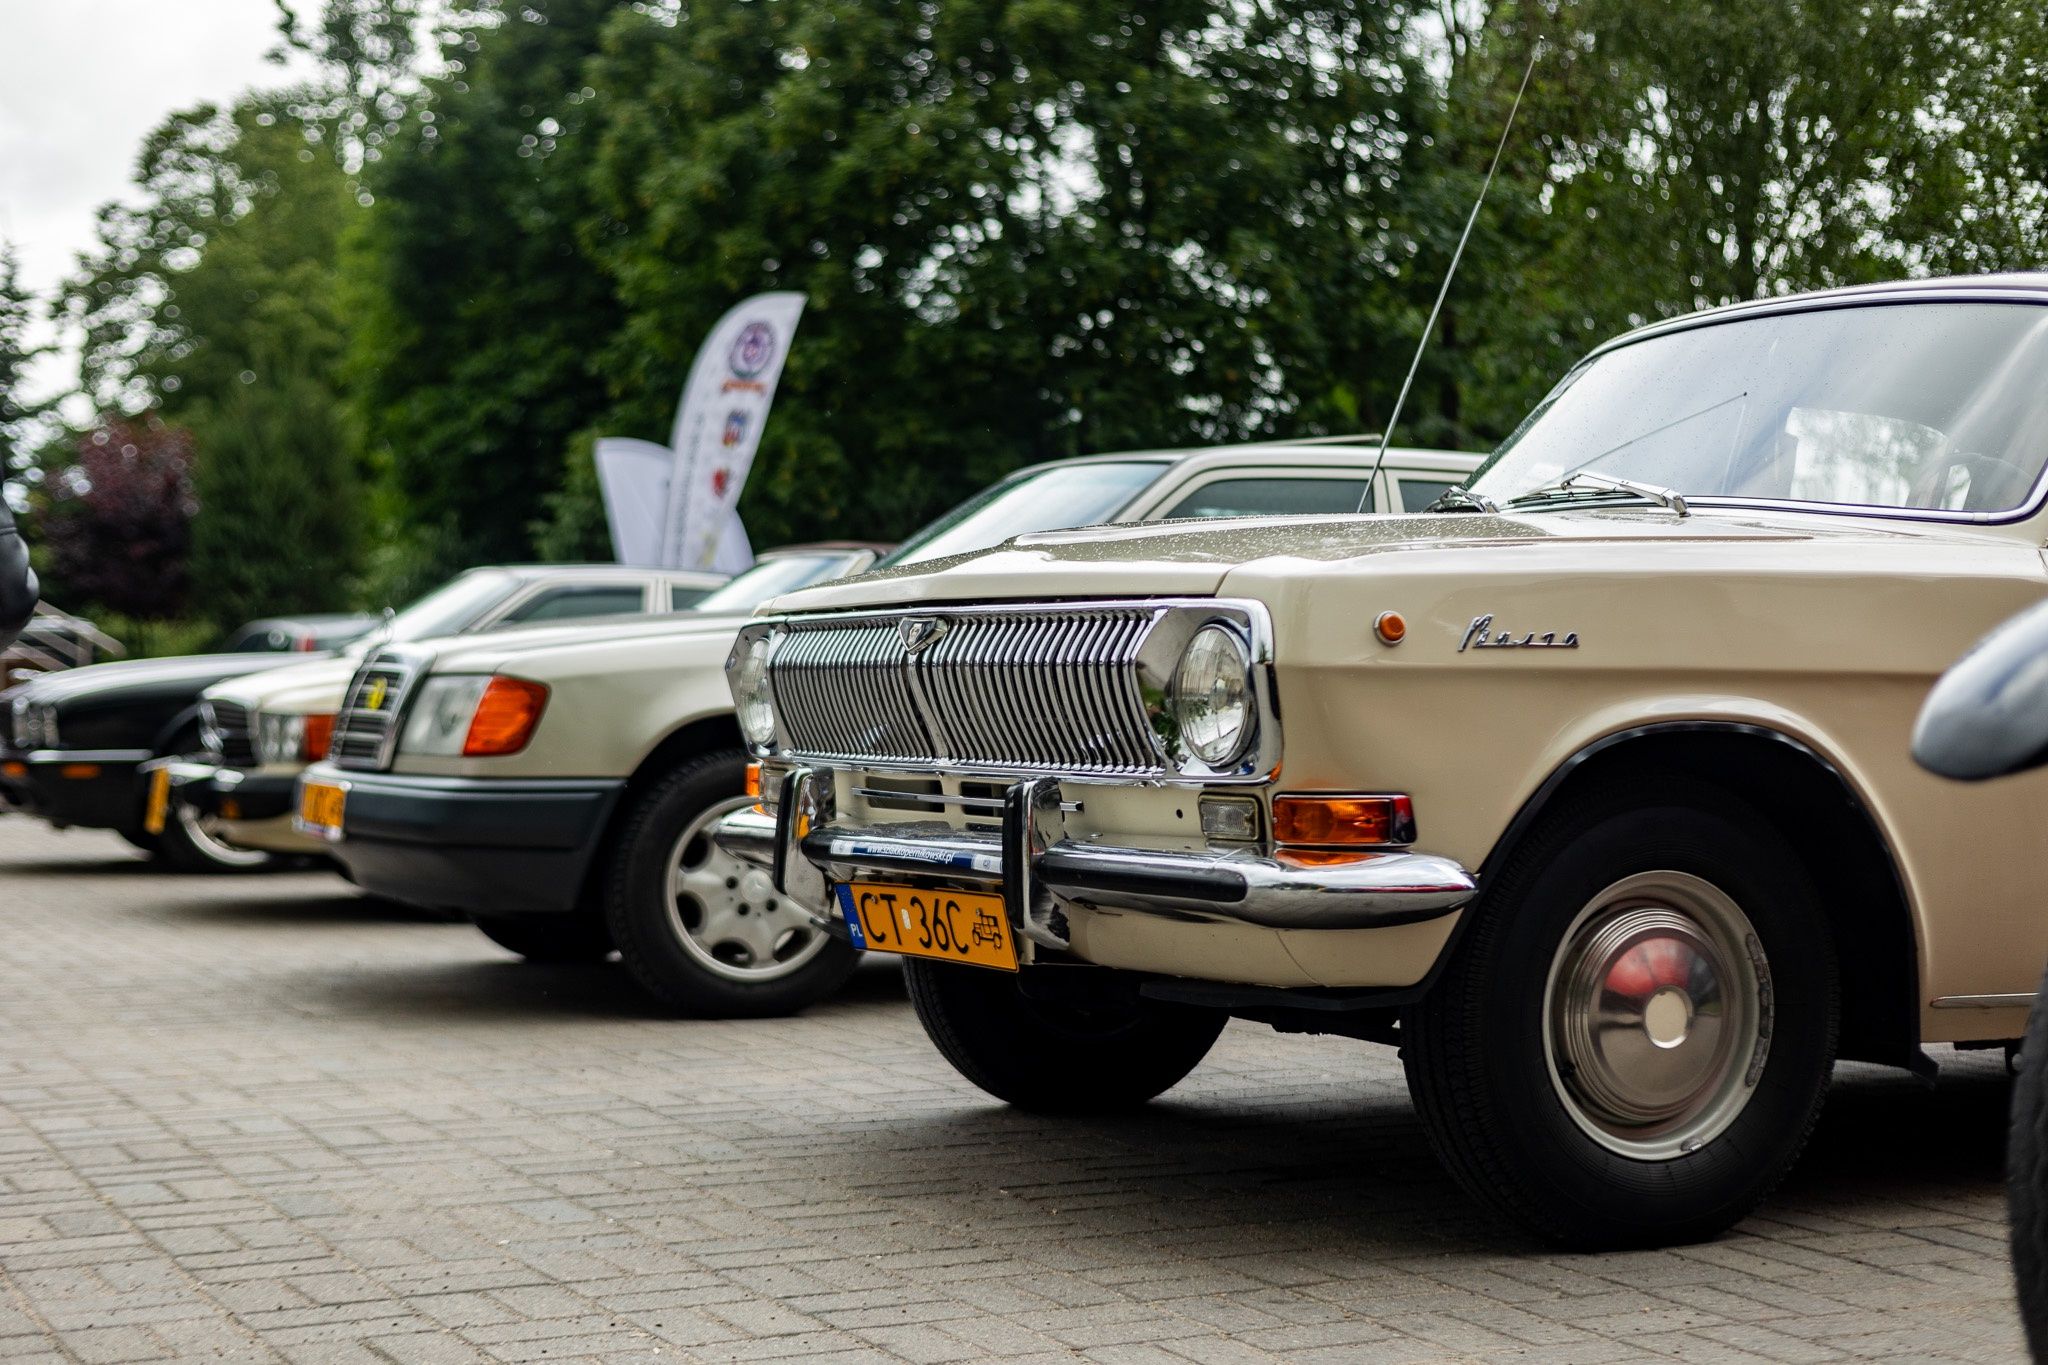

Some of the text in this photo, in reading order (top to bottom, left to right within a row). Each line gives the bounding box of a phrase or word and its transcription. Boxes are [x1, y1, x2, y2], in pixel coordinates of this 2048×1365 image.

[850, 923, 863, 938] PL
[860, 892, 969, 954] CT 36C
